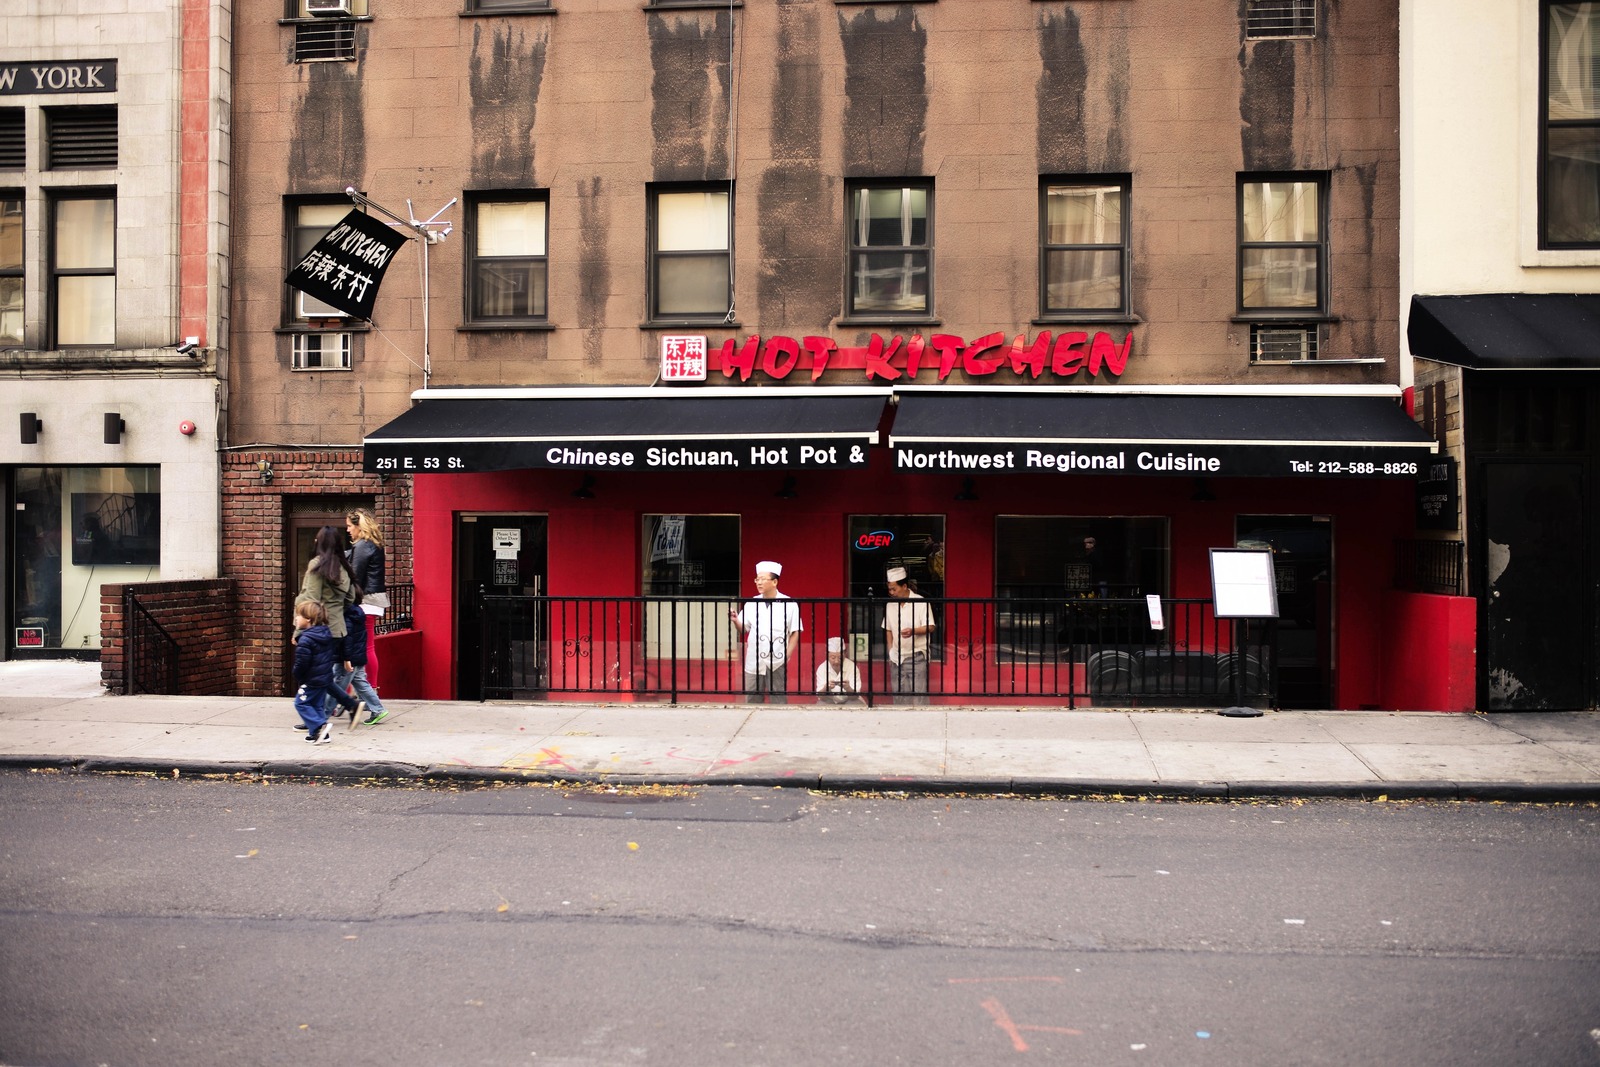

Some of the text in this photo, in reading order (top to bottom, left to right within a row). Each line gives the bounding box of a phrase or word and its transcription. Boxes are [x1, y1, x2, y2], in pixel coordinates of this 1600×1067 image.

[31, 66, 105, 89] YORK
[339, 228, 394, 270] KITCHEN
[720, 330, 1133, 382] HOT KITCHEN
[376, 457, 465, 469] 251 E. 53 St.
[546, 445, 865, 468] Chinese Sichuan, Hot Pot &
[897, 449, 1221, 473] Northwest Regional Cuisine
[1289, 460, 1314, 473] Tel:
[859, 534, 891, 547] OPEN
[856, 637, 866, 653] B
